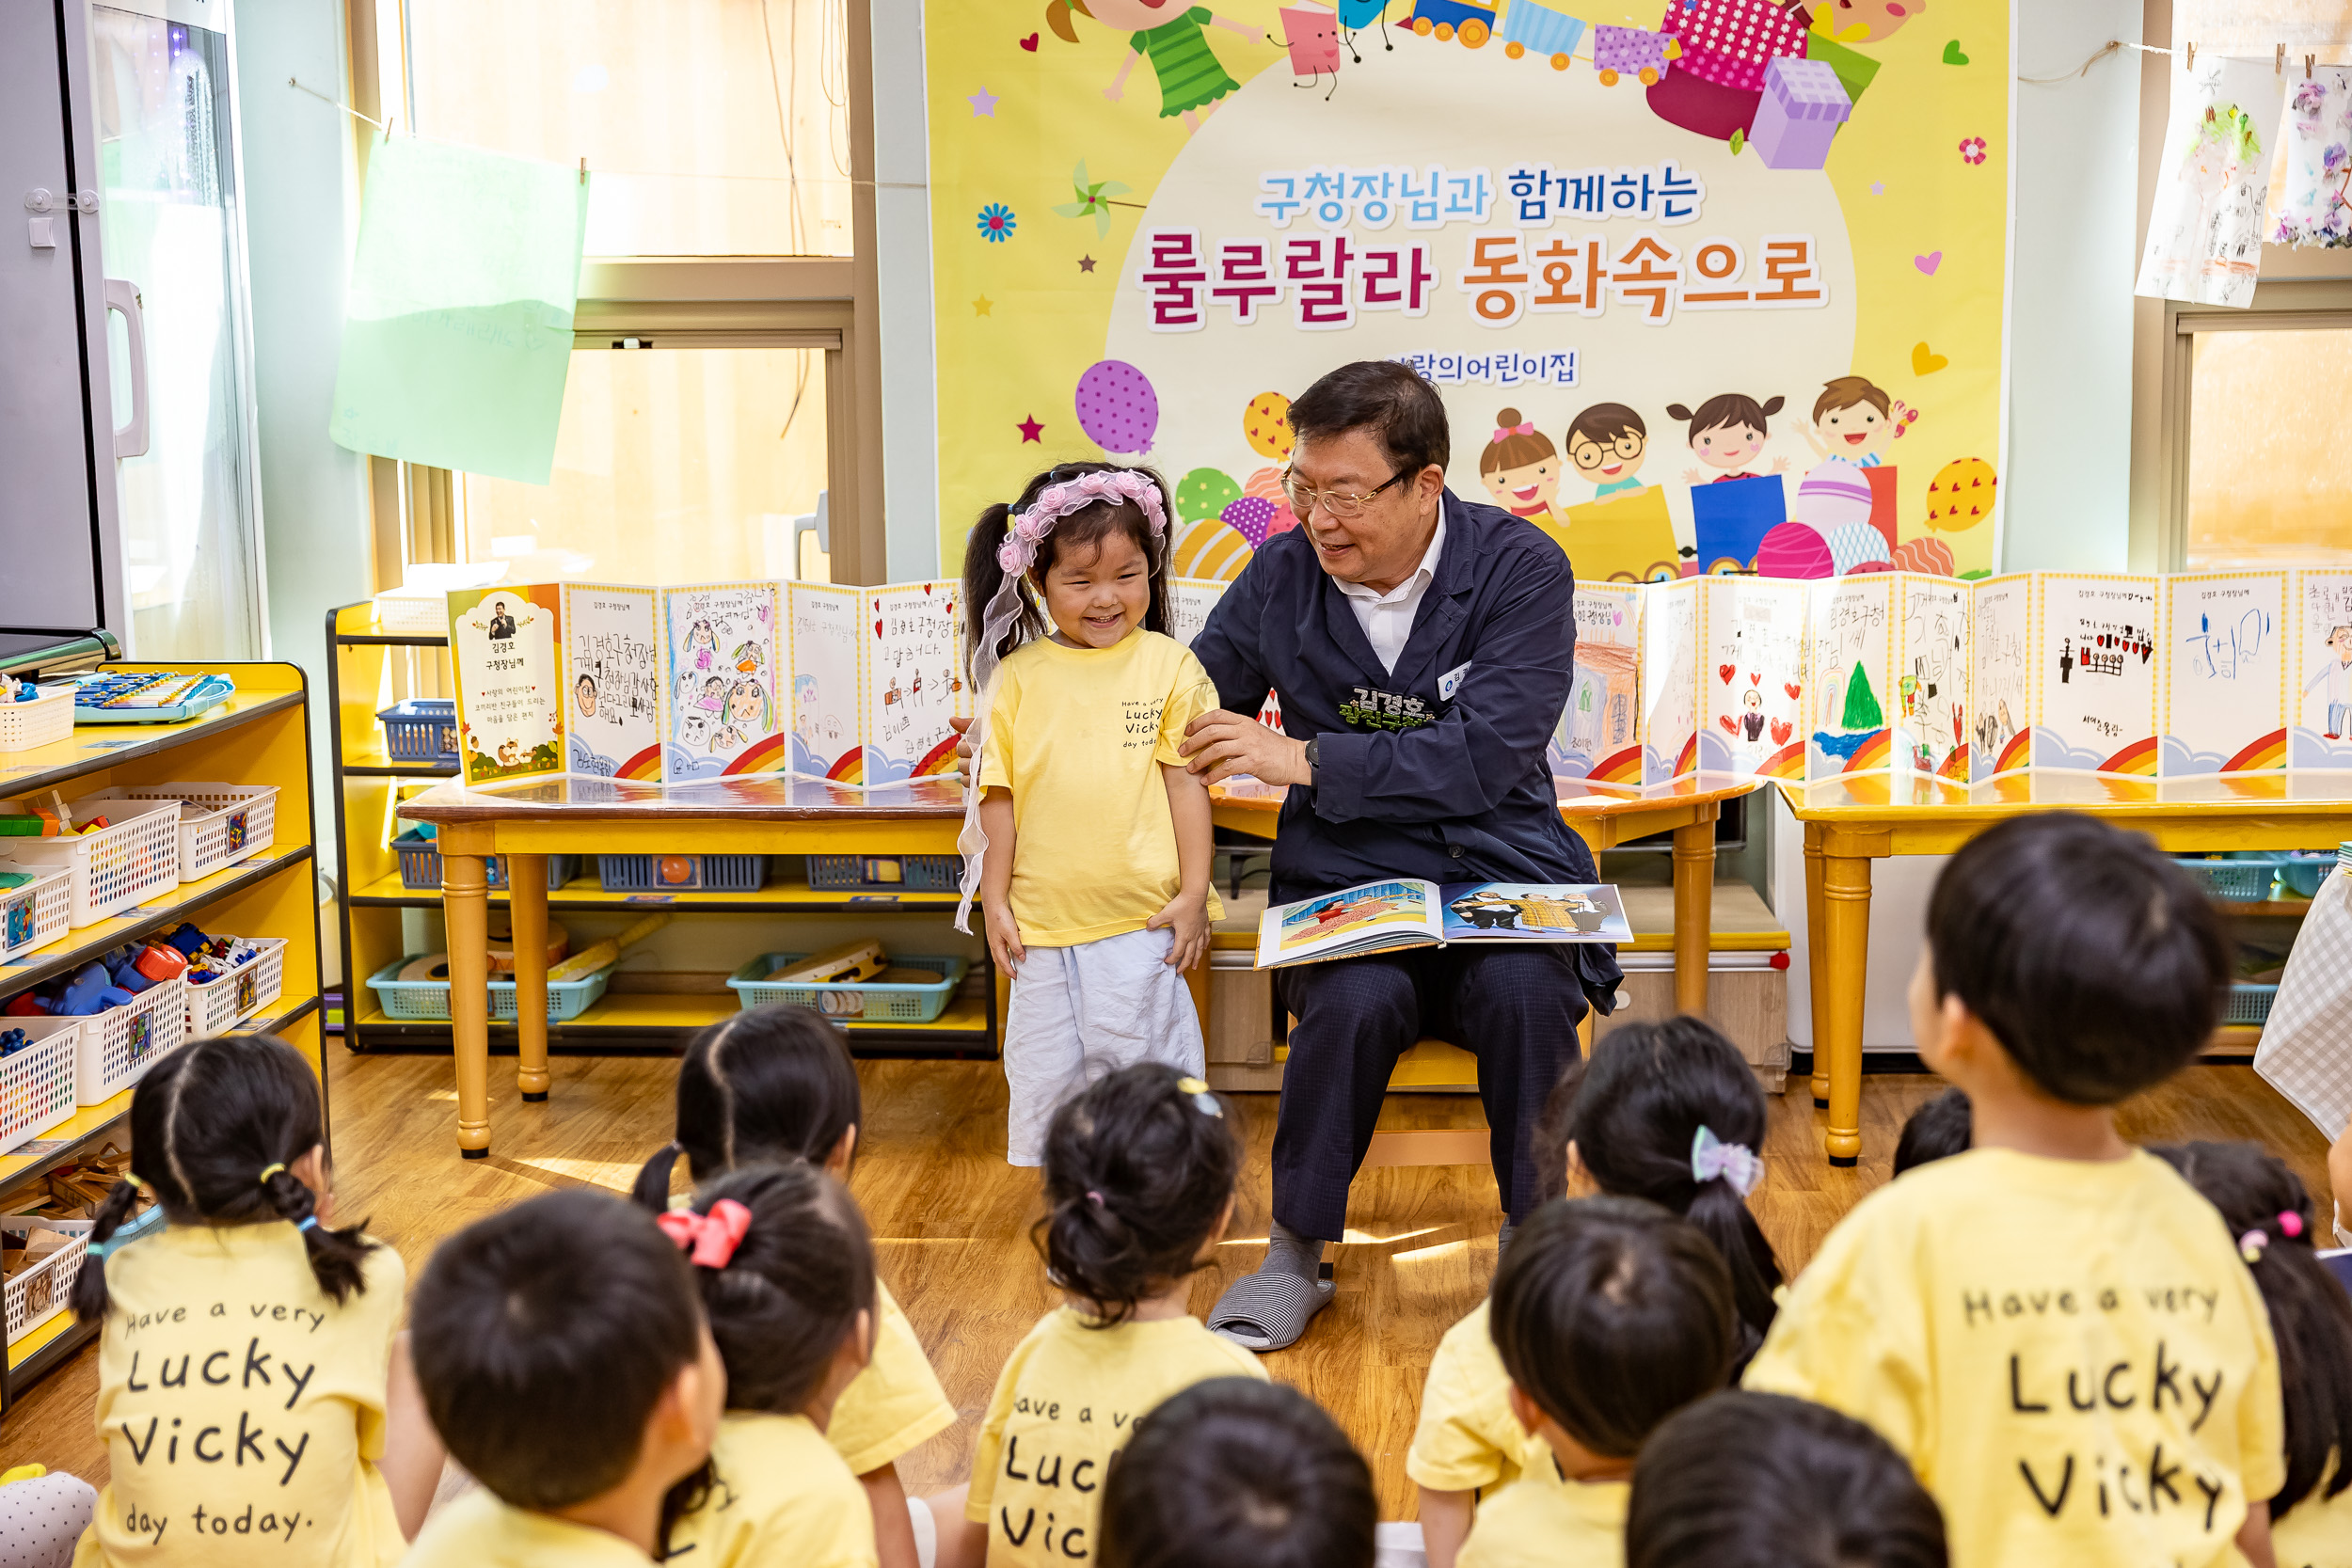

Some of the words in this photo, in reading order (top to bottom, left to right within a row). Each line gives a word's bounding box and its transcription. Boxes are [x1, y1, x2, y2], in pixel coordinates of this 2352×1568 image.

[1261, 170, 1489, 223] 구청장님과
[1507, 166, 1698, 221] 함께하는
[1142, 233, 1432, 324] 룰루랄라
[1463, 236, 1822, 320] 동화속으로
[609, 602, 630, 610] 구청장님께
[2201, 591, 2217, 600] 김경호
[2220, 589, 2250, 599] 구청장님께
[485, 657, 524, 671] 구청장님께
[492, 641, 516, 654] 김경호
[506, 685, 531, 695] 어린이집
[1353, 688, 1425, 719] 김경호
[1125, 708, 1163, 720] Lucky
[1339, 704, 1427, 730] 광진구청
[1141, 737, 1156, 746] tod
[124, 1306, 187, 1340] Have
[209, 1302, 227, 1317] a
[249, 1303, 326, 1334] very
[1963, 1286, 2079, 1330] Have
[2097, 1287, 2120, 1313] a
[2145, 1286, 2220, 1324] very
[127, 1337, 315, 1410] Lucky
[2010, 1338, 2223, 1436] Lucky
[1014, 1398, 1060, 1420] ave
[1079, 1406, 1092, 1423] a
[120, 1411, 310, 1487] Vicky
[1006, 1435, 1097, 1493] Luc
[2018, 1442, 2223, 1533] Vicky
[126, 1503, 167, 1546] day
[191, 1504, 312, 1543] today.
[1001, 1506, 1089, 1560] Vic
